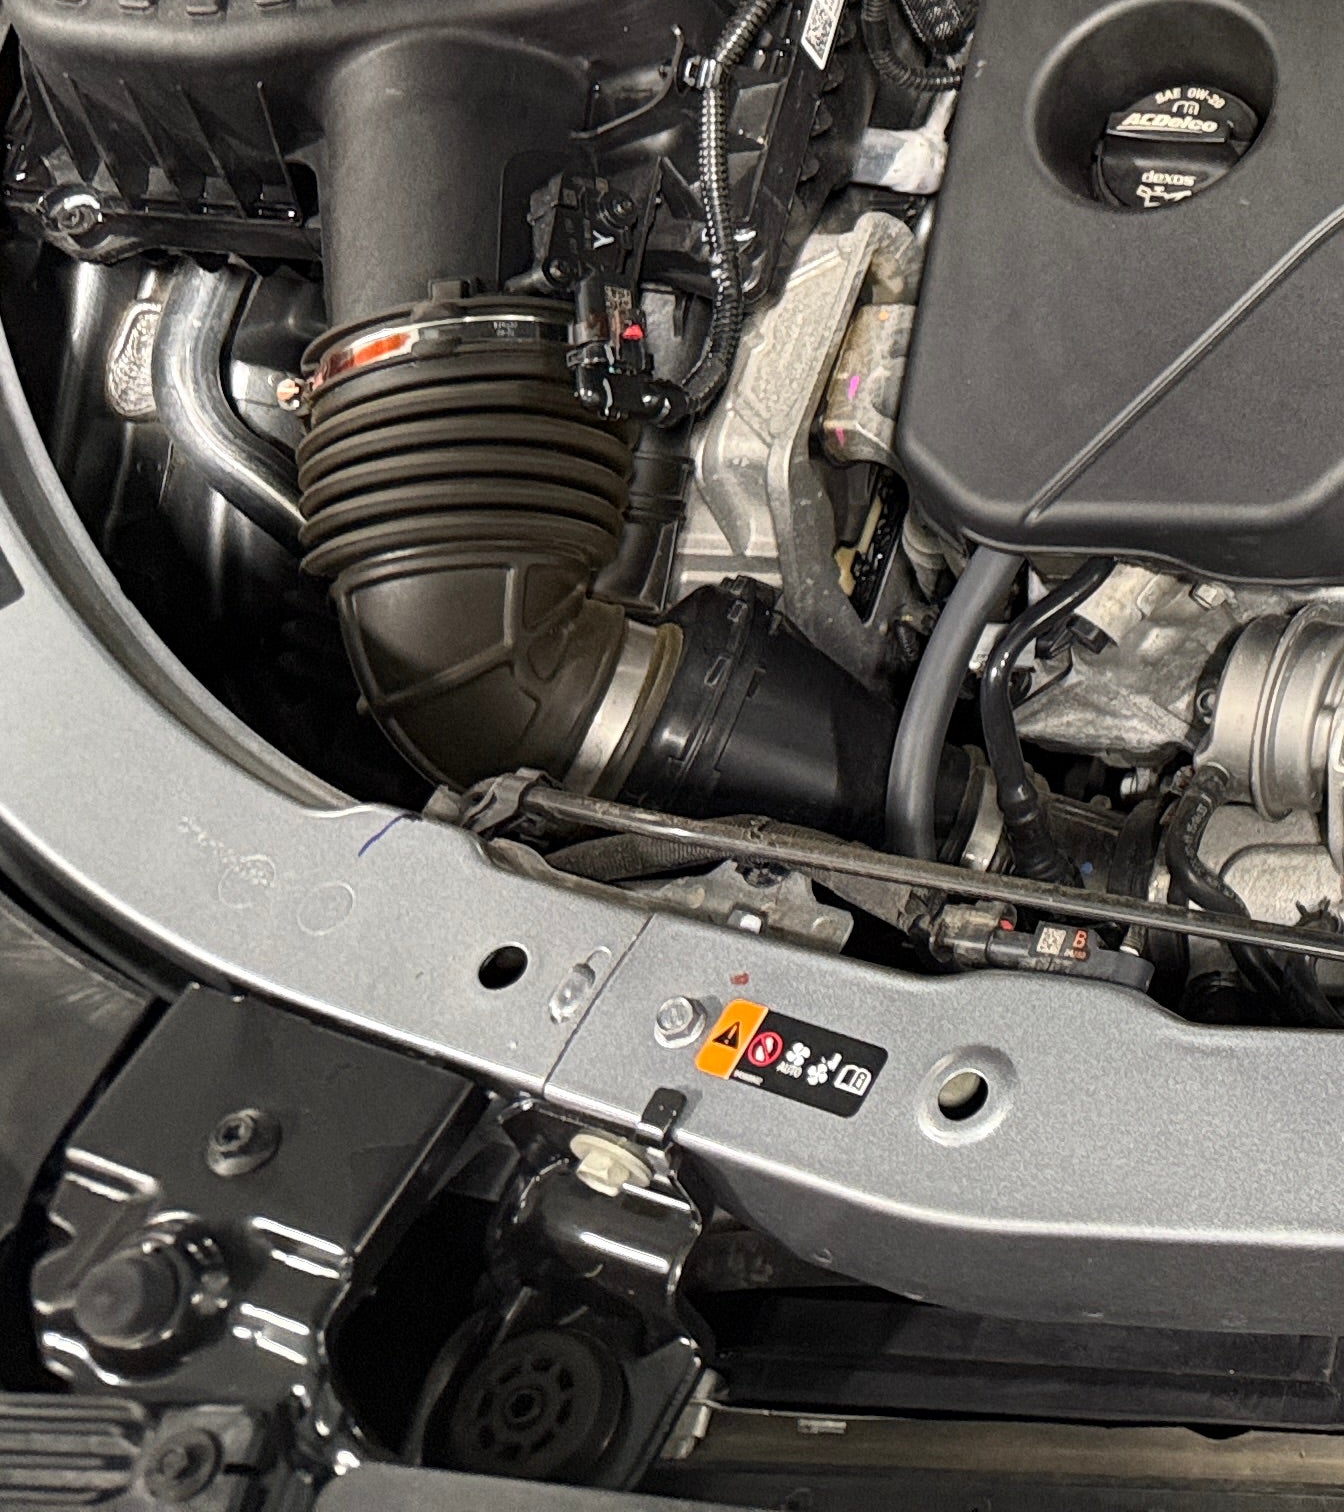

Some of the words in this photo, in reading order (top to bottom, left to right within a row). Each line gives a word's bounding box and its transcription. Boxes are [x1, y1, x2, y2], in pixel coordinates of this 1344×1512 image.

[1119, 112, 1219, 133] ACDelco
[1141, 170, 1197, 187] dexos
[776, 1060, 803, 1079] AUTO
